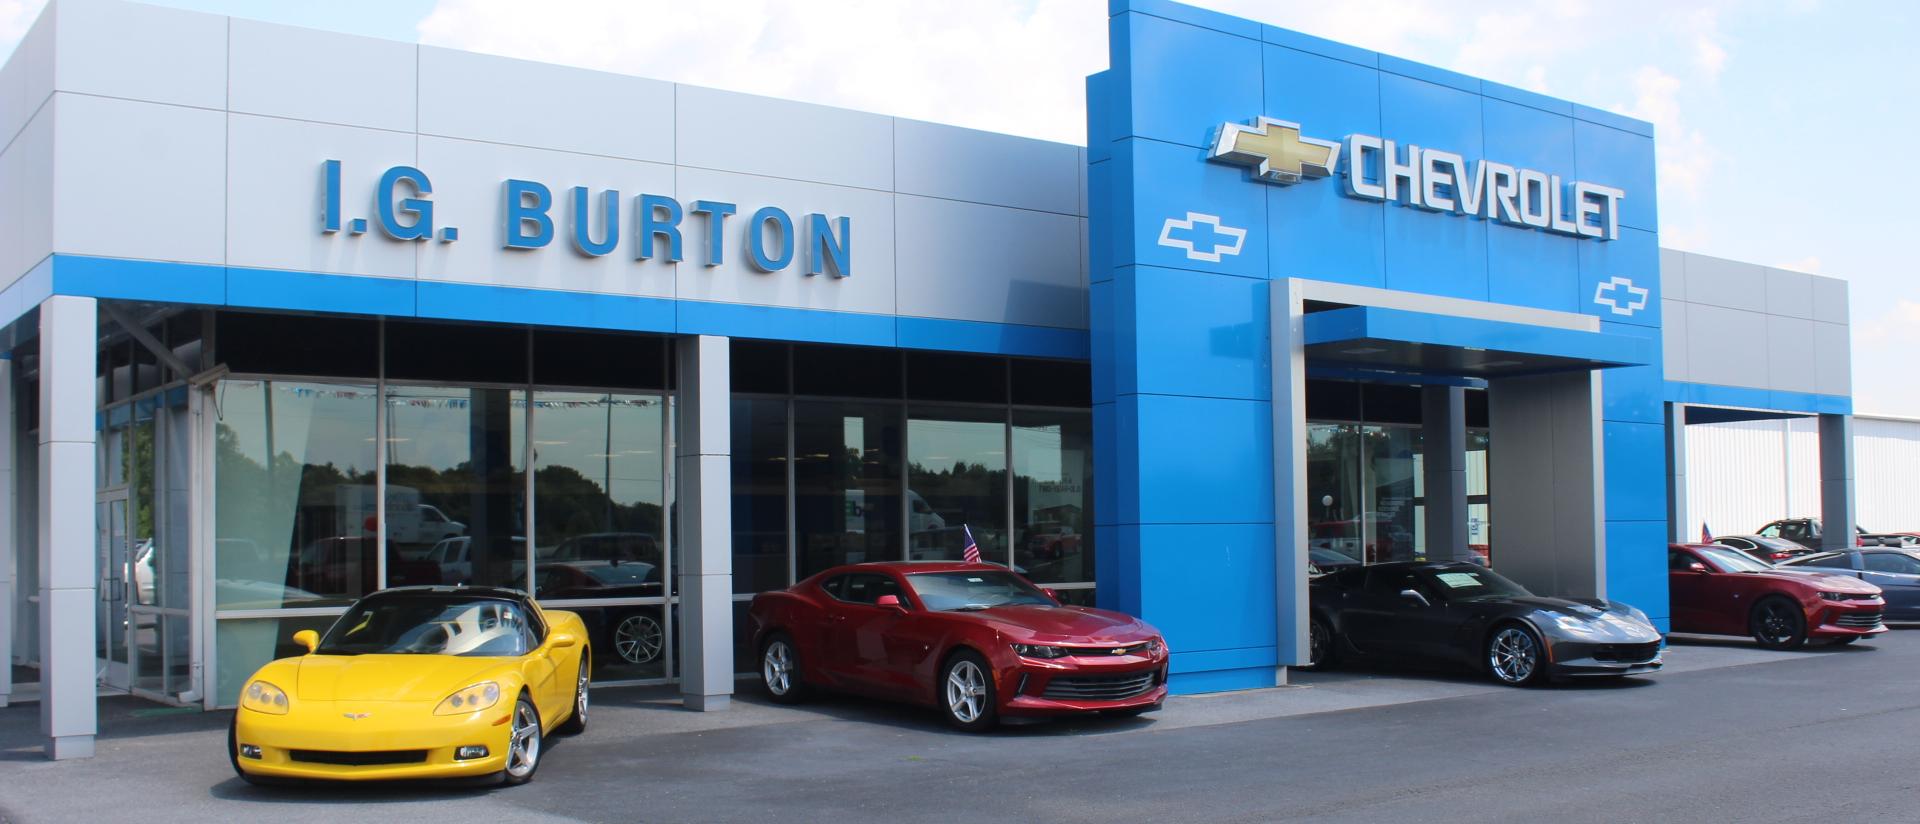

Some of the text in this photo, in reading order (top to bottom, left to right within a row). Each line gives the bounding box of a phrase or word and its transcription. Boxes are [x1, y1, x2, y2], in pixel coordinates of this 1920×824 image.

[319, 159, 851, 278] I.G. BURTON
[1345, 134, 1625, 240] CHEVROLET
